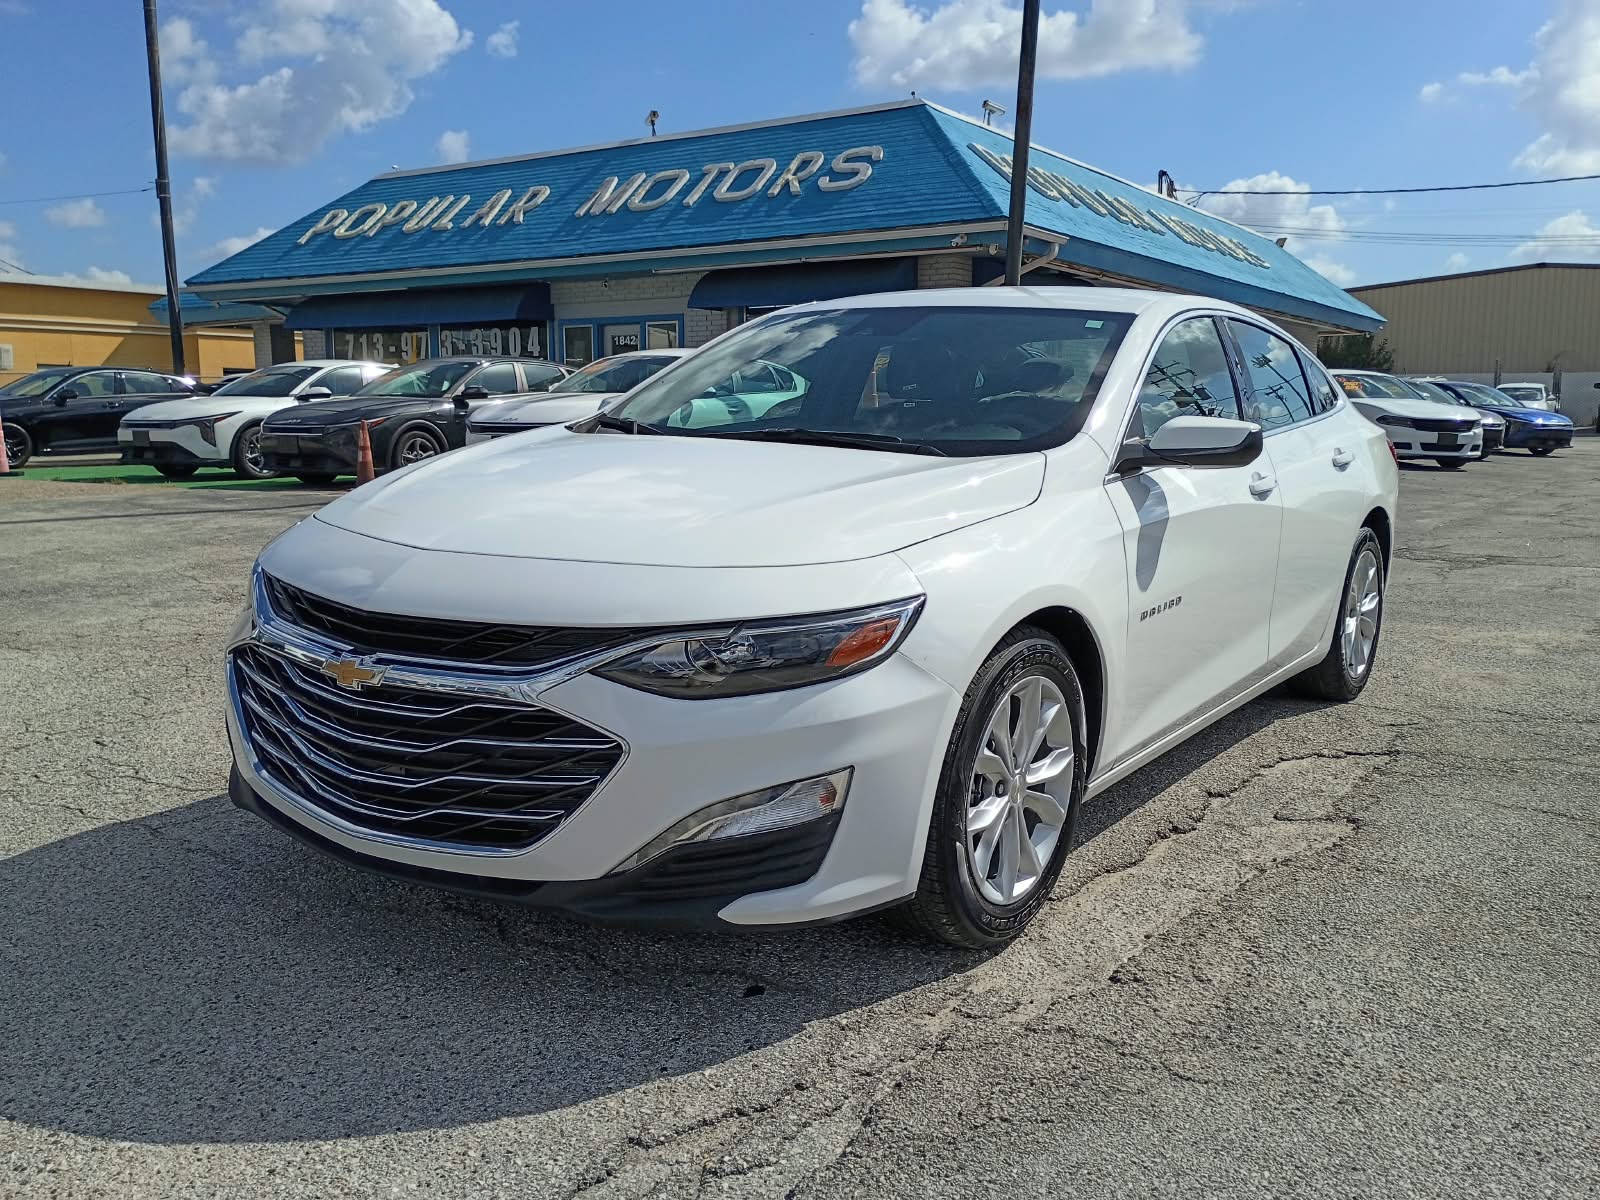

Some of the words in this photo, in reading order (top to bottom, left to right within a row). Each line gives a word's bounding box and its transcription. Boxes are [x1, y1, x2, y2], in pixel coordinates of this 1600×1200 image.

[297, 185, 551, 245] POPULAR
[575, 145, 884, 218] MOTORS
[614, 335, 636, 346] 1842
